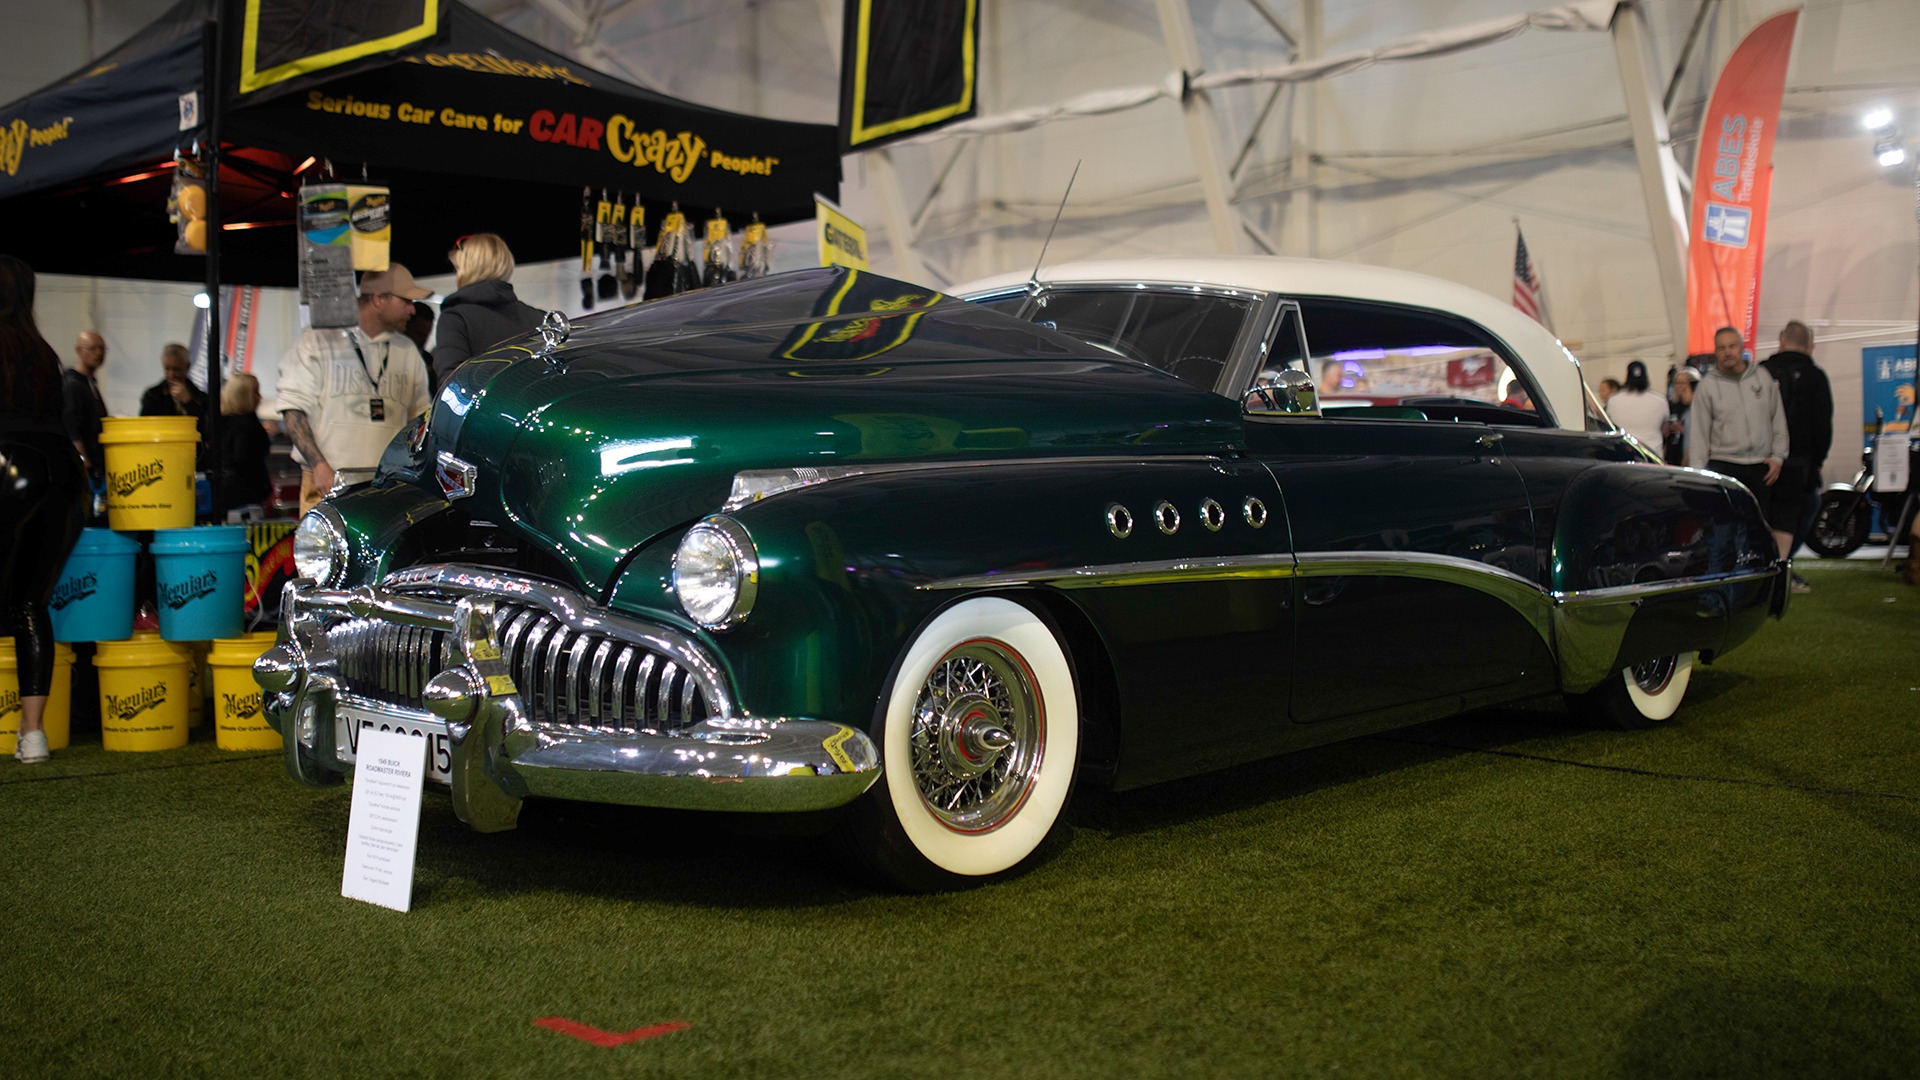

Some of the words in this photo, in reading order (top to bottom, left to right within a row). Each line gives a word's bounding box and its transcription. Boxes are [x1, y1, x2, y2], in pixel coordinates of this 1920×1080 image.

[307, 91, 390, 120] Serious
[397, 103, 435, 125] Car
[440, 108, 488, 131] Care
[493, 114, 523, 135] for
[528, 109, 604, 150] CAR
[606, 114, 707, 184] Crazy
[1712, 114, 1747, 200] ABES
[105, 681, 167, 720] Meguiar's
[366, 764, 394, 775] ROADMASTER
[394, 768, 411, 778] RIVIERA
